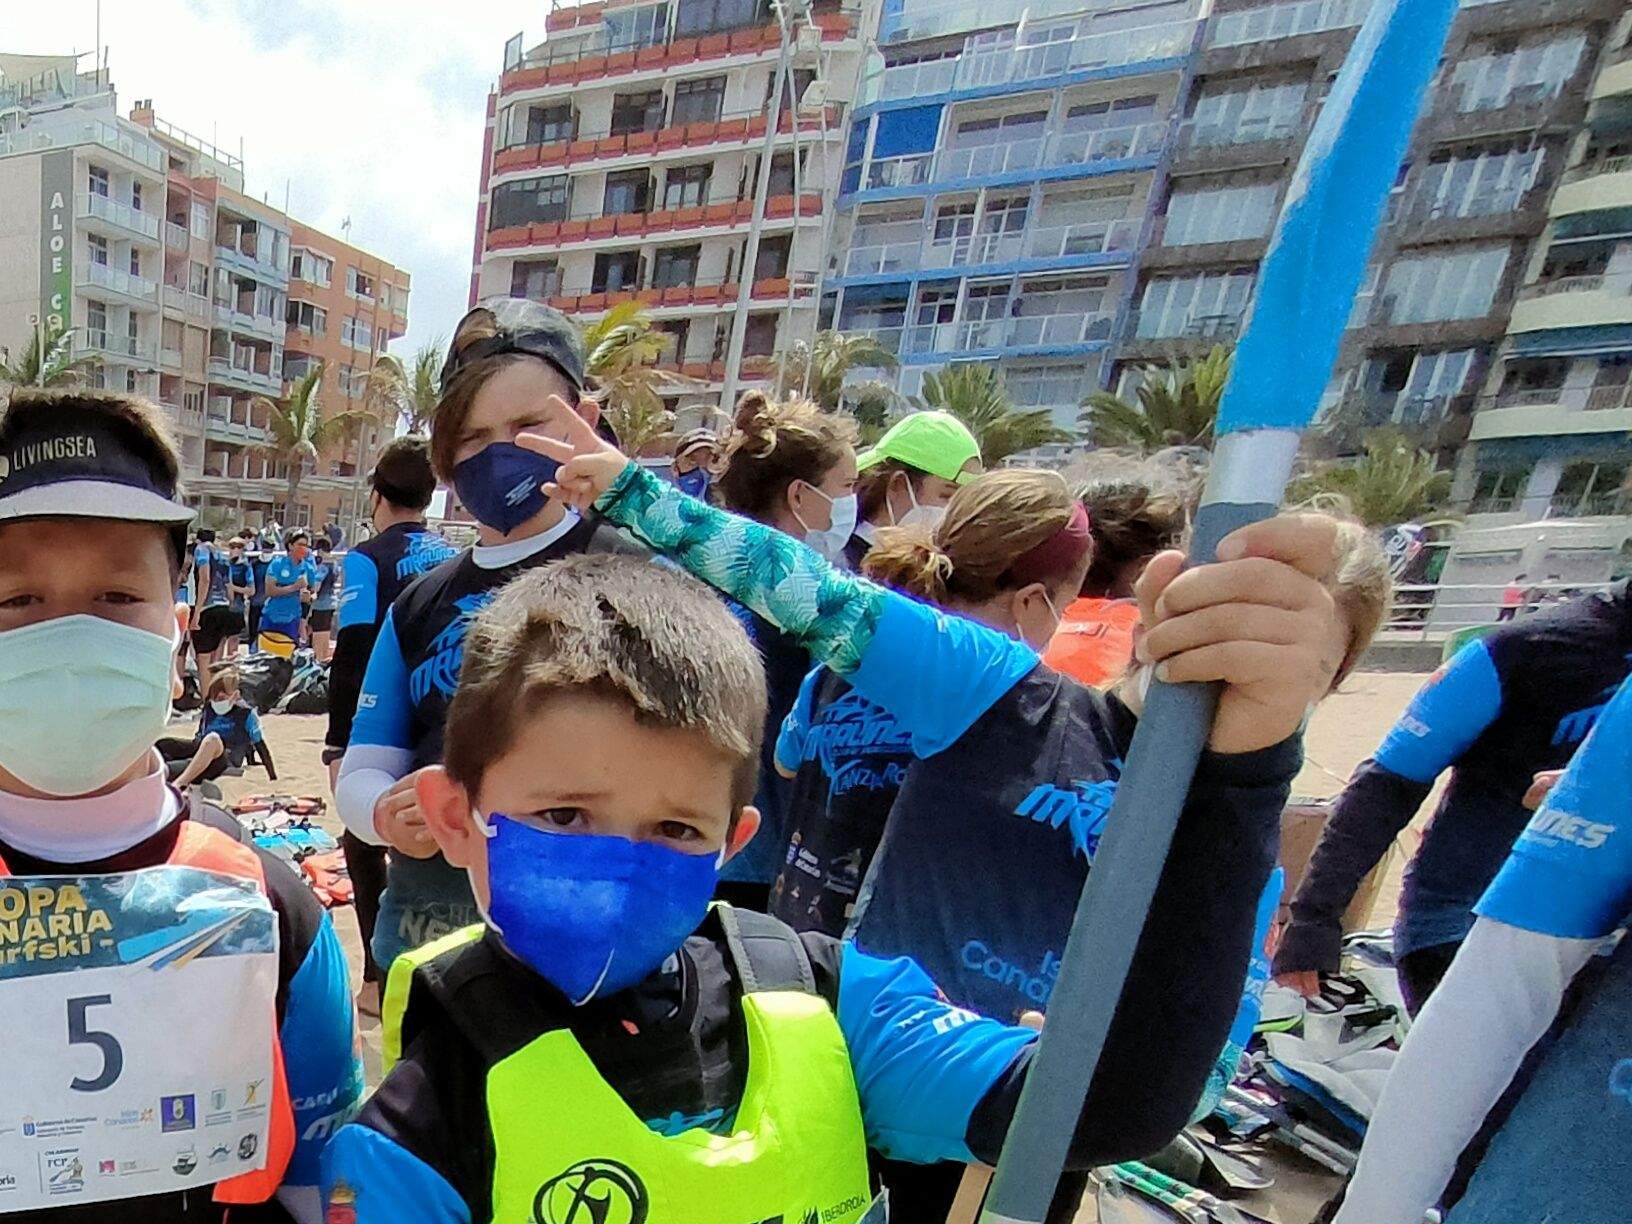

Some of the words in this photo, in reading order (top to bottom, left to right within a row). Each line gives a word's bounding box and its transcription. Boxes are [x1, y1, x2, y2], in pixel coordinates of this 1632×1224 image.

[49, 191, 65, 274] ALOE
[14, 435, 97, 471] LIVINGSEA
[67, 994, 124, 1093] 5
